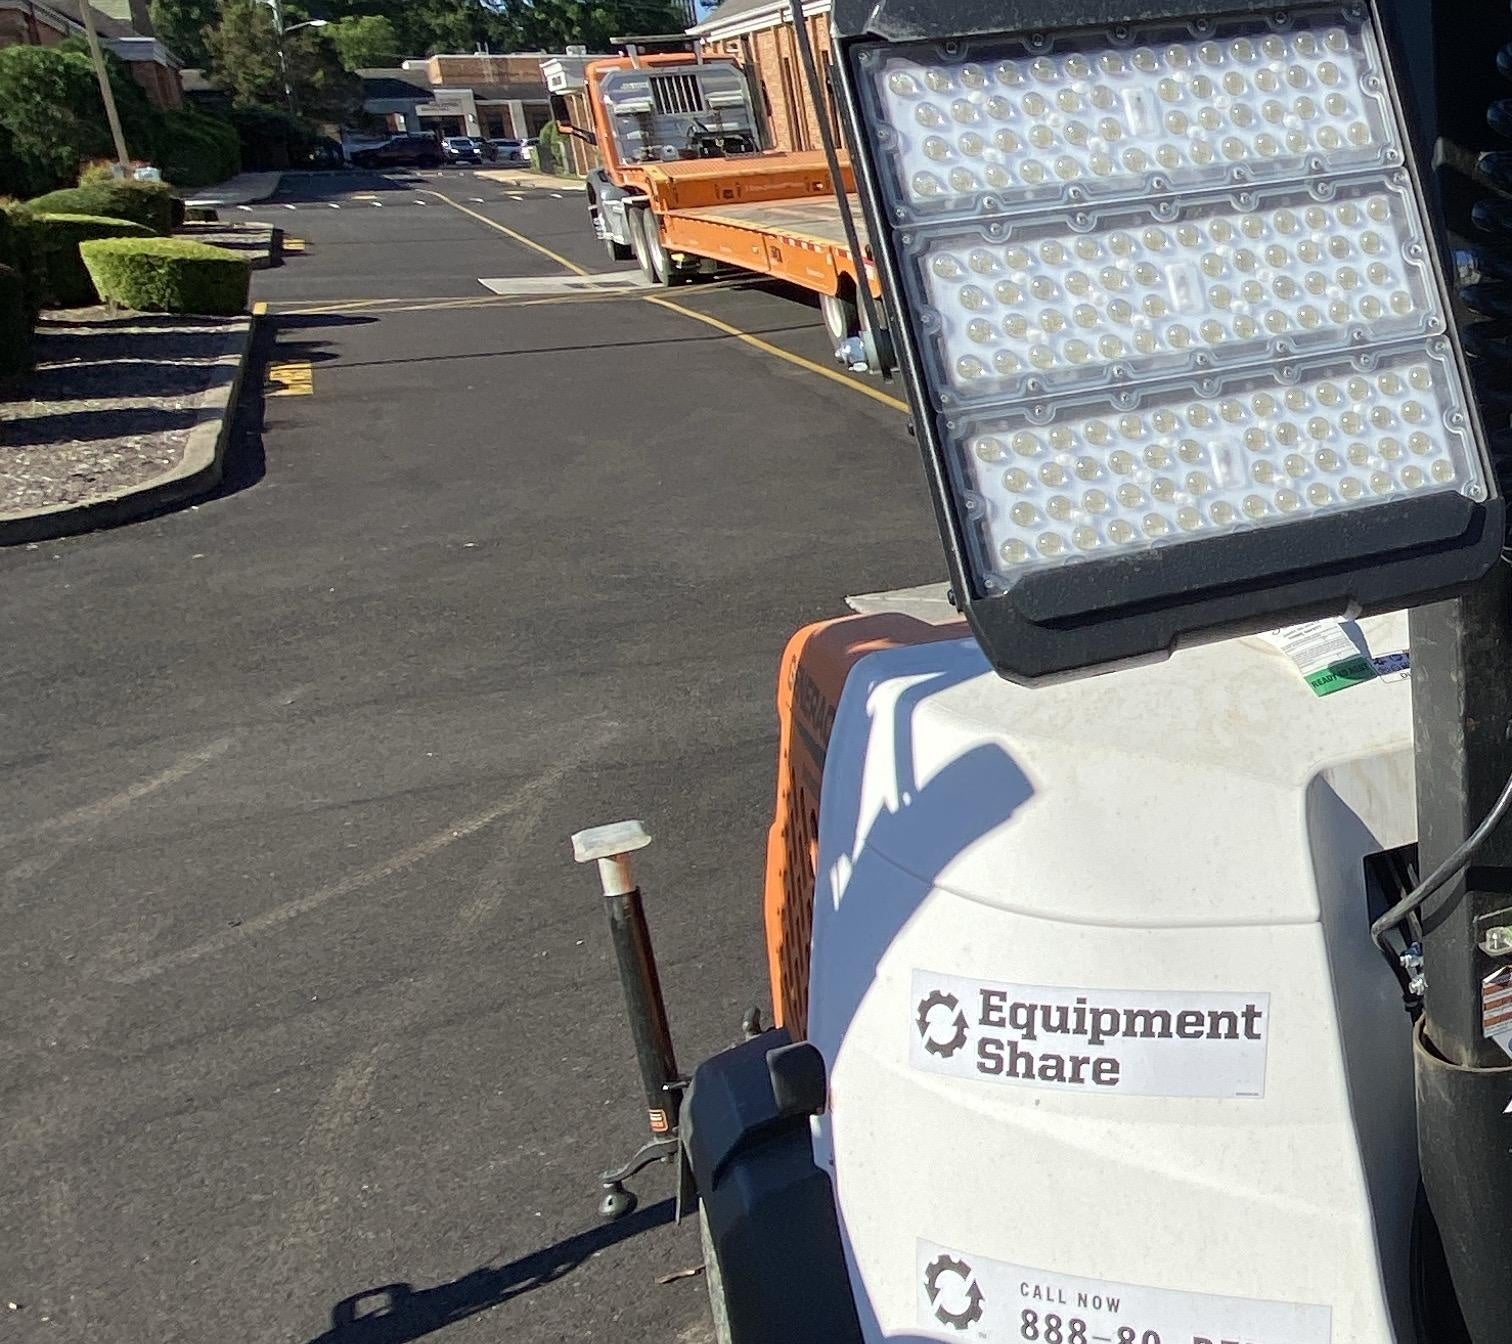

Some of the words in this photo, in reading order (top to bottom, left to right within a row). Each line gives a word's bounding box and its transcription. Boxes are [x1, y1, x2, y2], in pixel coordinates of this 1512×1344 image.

[978, 988, 1262, 1045] Equipment
[977, 1037, 1120, 1086] Share
[1020, 1282, 1067, 1304] CALL
[1077, 1293, 1121, 1313] NOW
